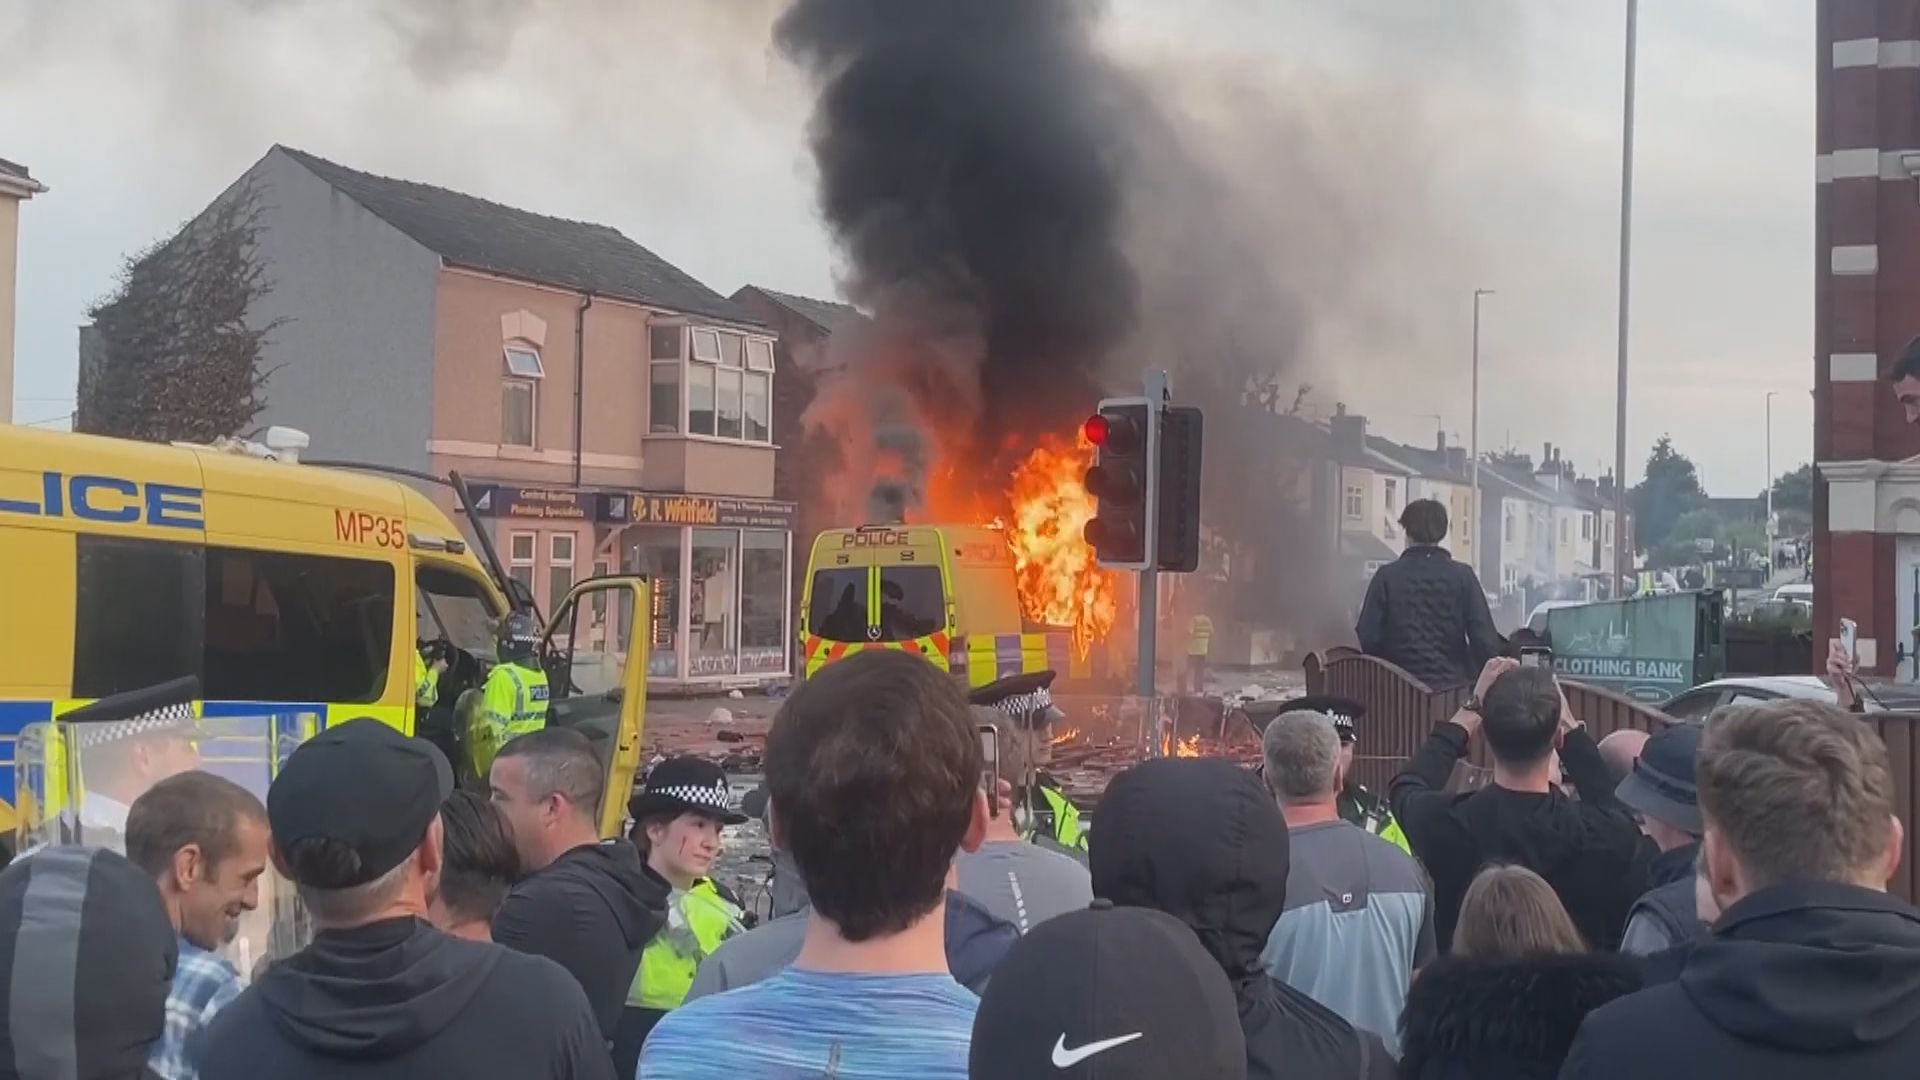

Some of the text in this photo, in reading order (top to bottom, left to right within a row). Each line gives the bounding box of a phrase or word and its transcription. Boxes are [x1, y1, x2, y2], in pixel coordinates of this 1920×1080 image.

[335, 508, 405, 549] MP35
[843, 530, 909, 548] POLICE
[1553, 657, 1684, 678] CLOTHING BANK
